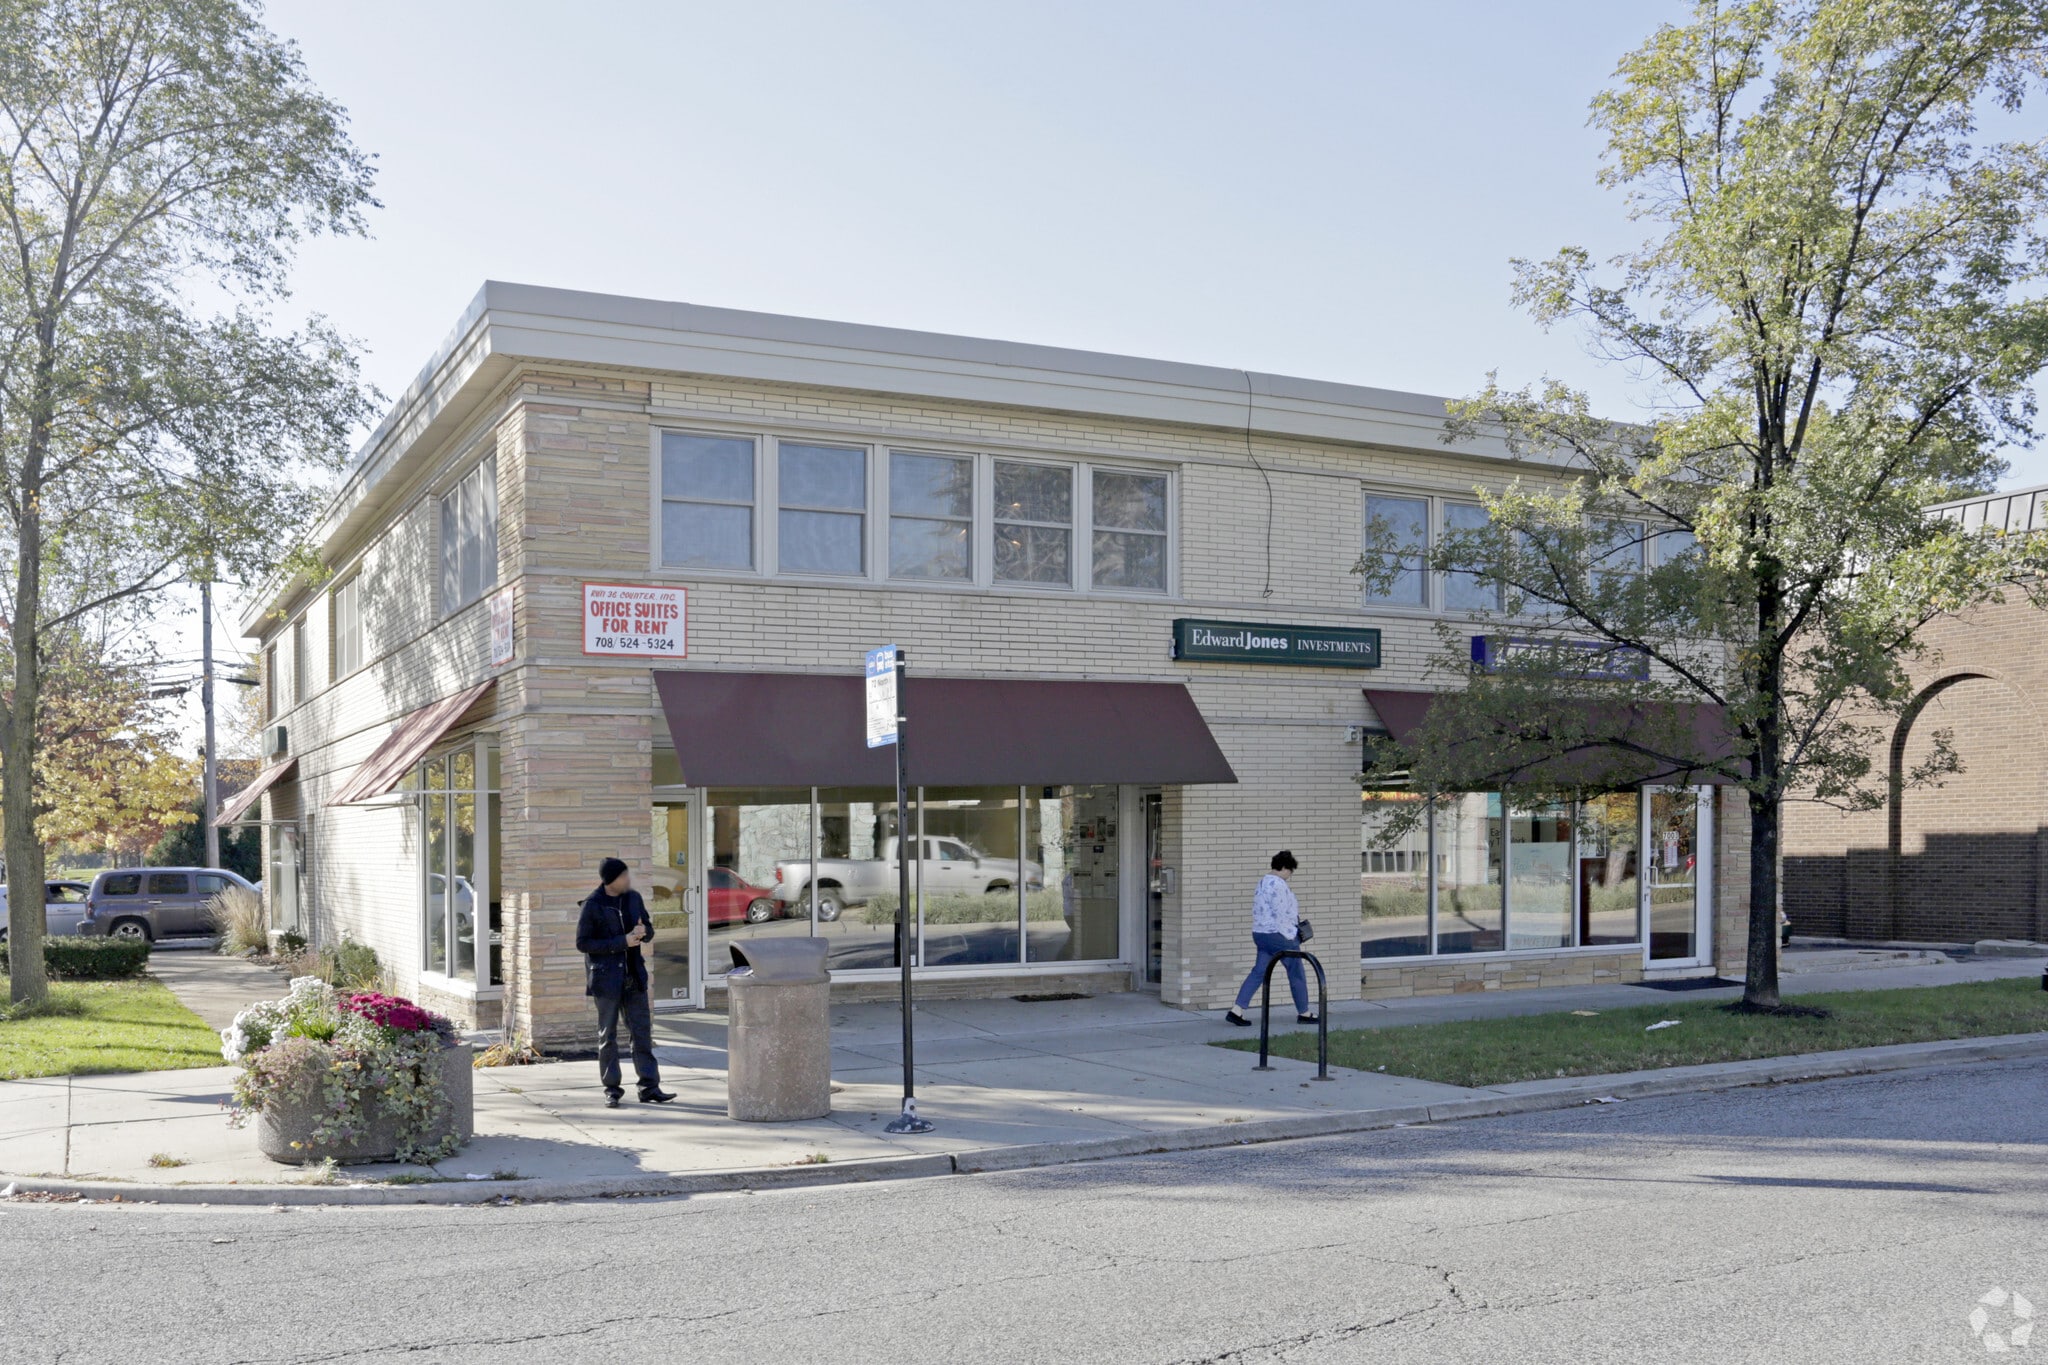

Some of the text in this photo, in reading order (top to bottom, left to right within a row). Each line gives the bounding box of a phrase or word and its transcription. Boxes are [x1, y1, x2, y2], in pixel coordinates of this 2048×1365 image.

[607, 591, 617, 599] 36
[590, 601, 679, 619] OFFICE SUITES
[602, 618, 668, 635] FOR RENT
[1297, 639, 1371, 653] INVESTMENTS
